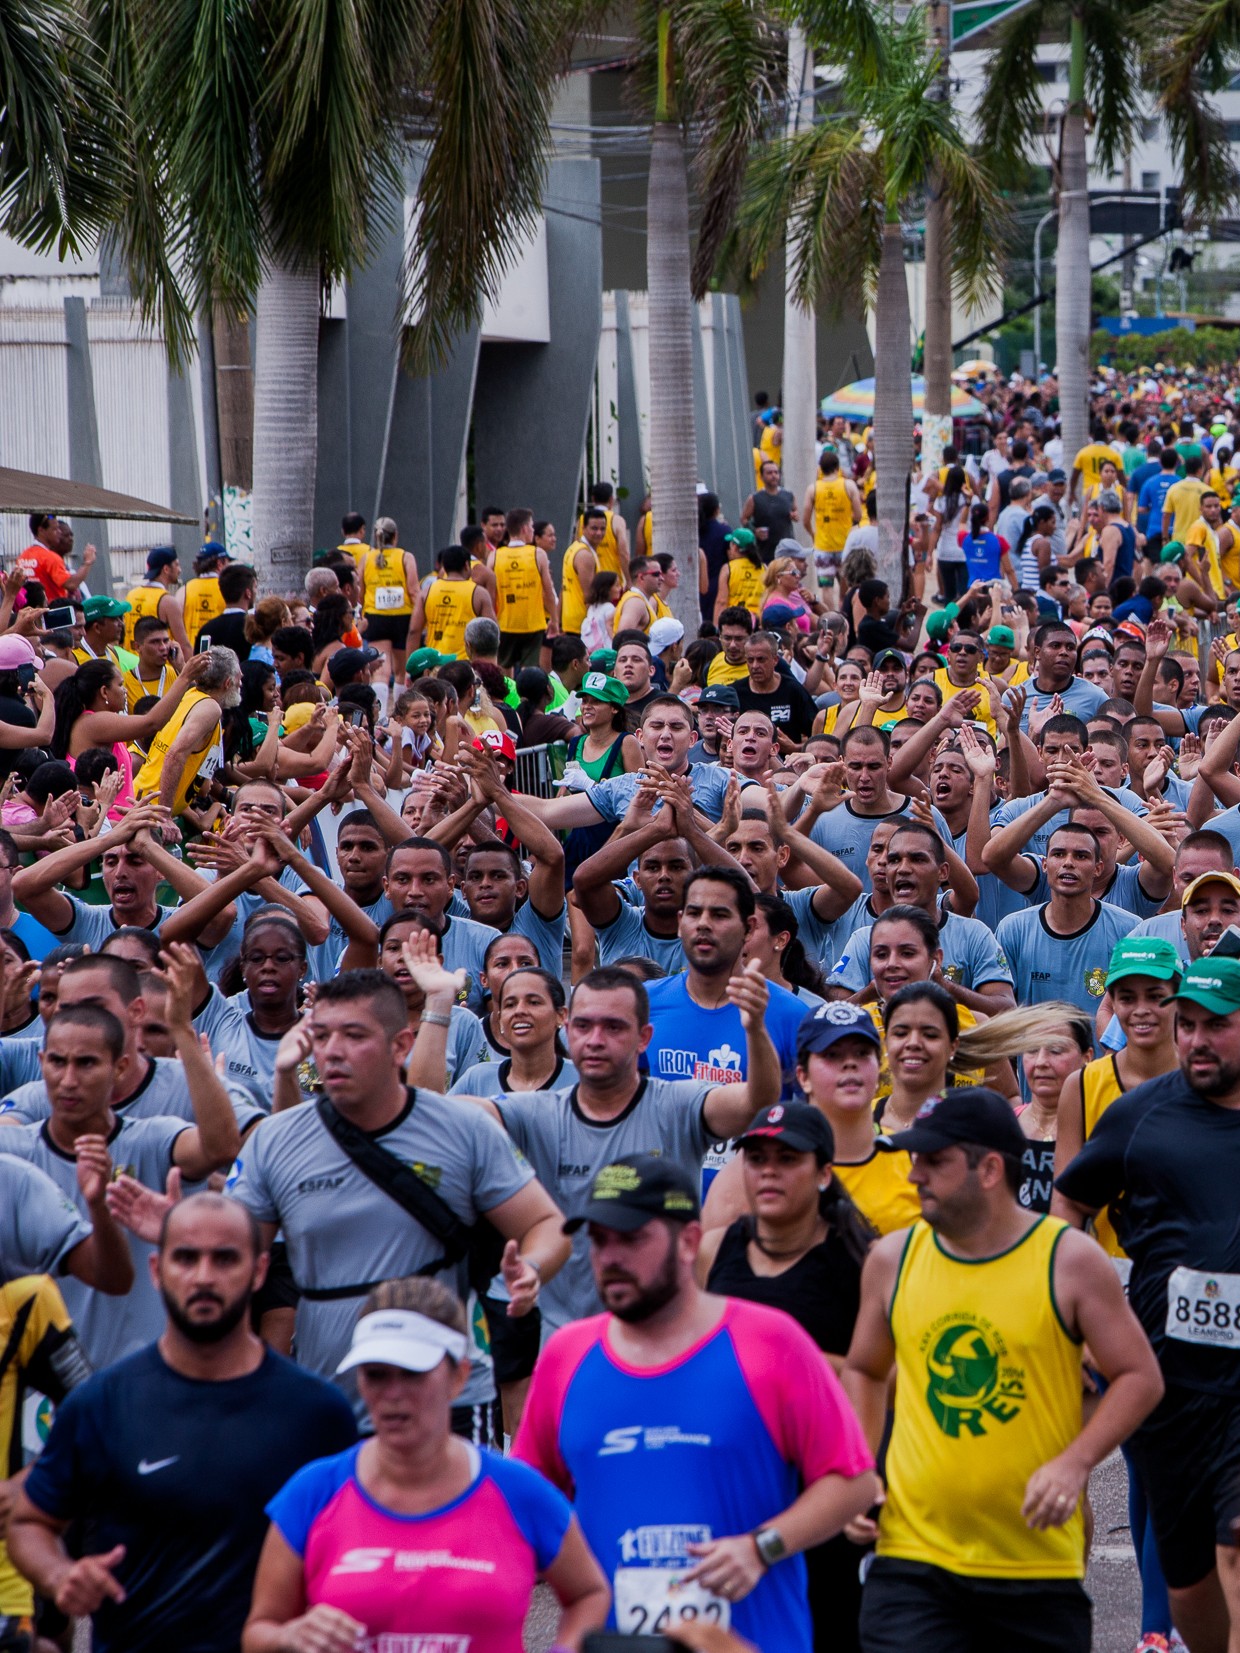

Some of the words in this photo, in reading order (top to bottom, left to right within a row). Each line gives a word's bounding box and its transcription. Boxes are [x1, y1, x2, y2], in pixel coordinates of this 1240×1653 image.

[592, 676, 597, 687] L
[486, 733, 499, 743] M
[831, 846, 855, 857] ESFAP
[659, 1049, 697, 1078] IRON
[692, 1061, 742, 1084] Fitness
[298, 1177, 345, 1192] ESFAP
[1187, 1326, 1235, 1341] LEANDRO
